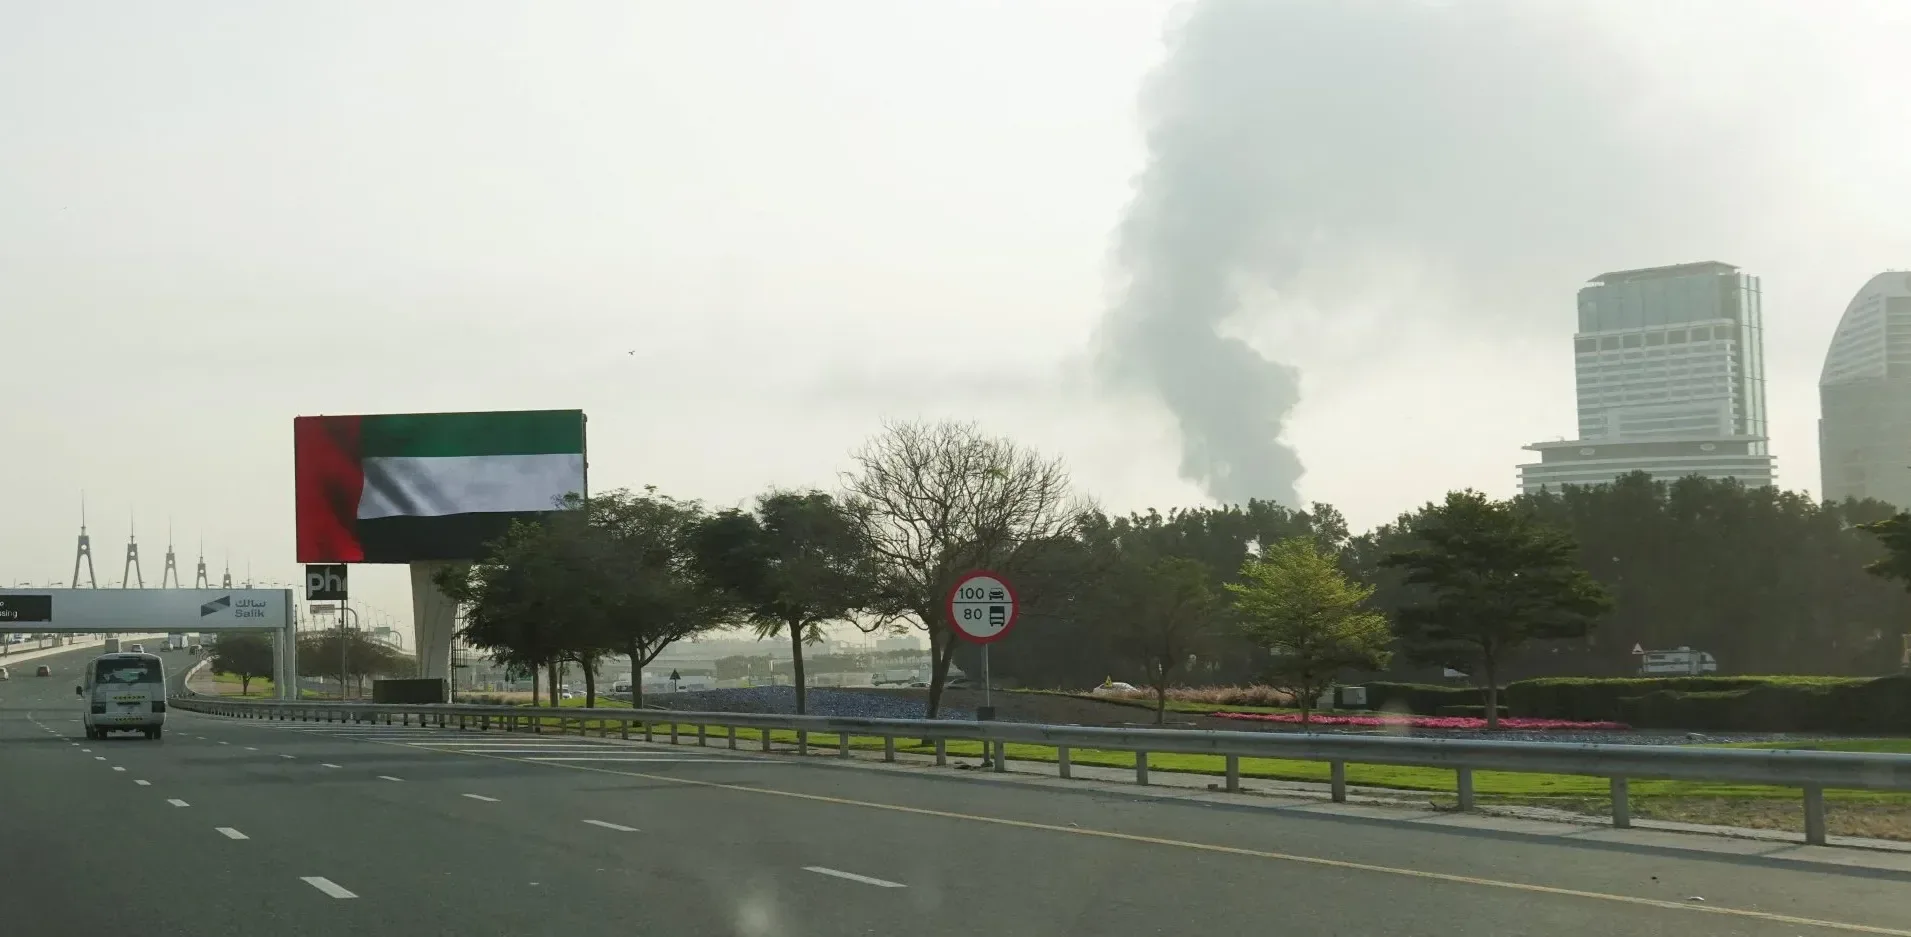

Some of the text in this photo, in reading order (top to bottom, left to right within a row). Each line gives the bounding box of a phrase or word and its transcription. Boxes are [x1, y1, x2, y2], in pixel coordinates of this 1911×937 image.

[307, 566, 347, 599] ph
[959, 587, 985, 599] 100
[235, 599, 266, 607] سالك
[235, 608, 265, 618] Salik
[964, 608, 982, 620] 80
